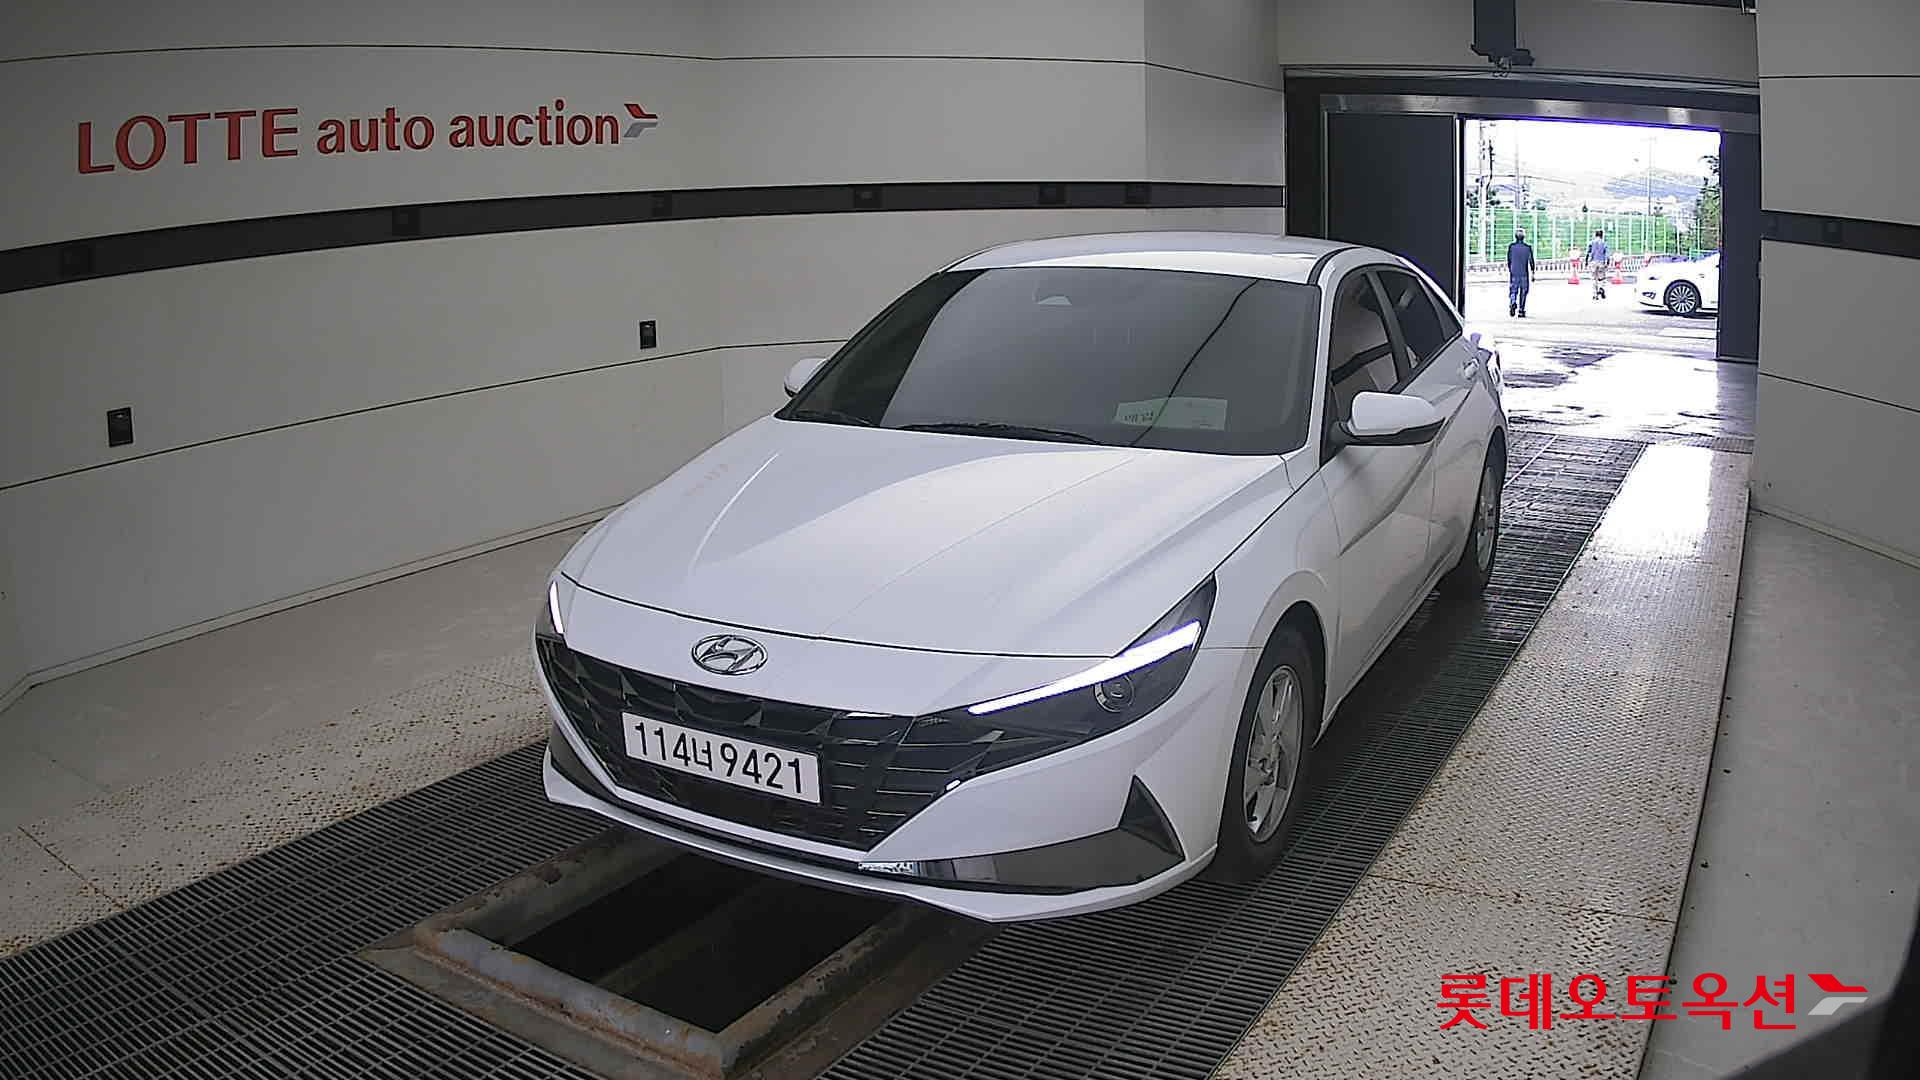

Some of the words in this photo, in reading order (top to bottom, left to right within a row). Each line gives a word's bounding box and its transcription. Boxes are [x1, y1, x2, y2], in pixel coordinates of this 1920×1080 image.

[78, 106, 298, 174] LOTTE
[316, 107, 435, 154] auto
[449, 99, 620, 148] auction
